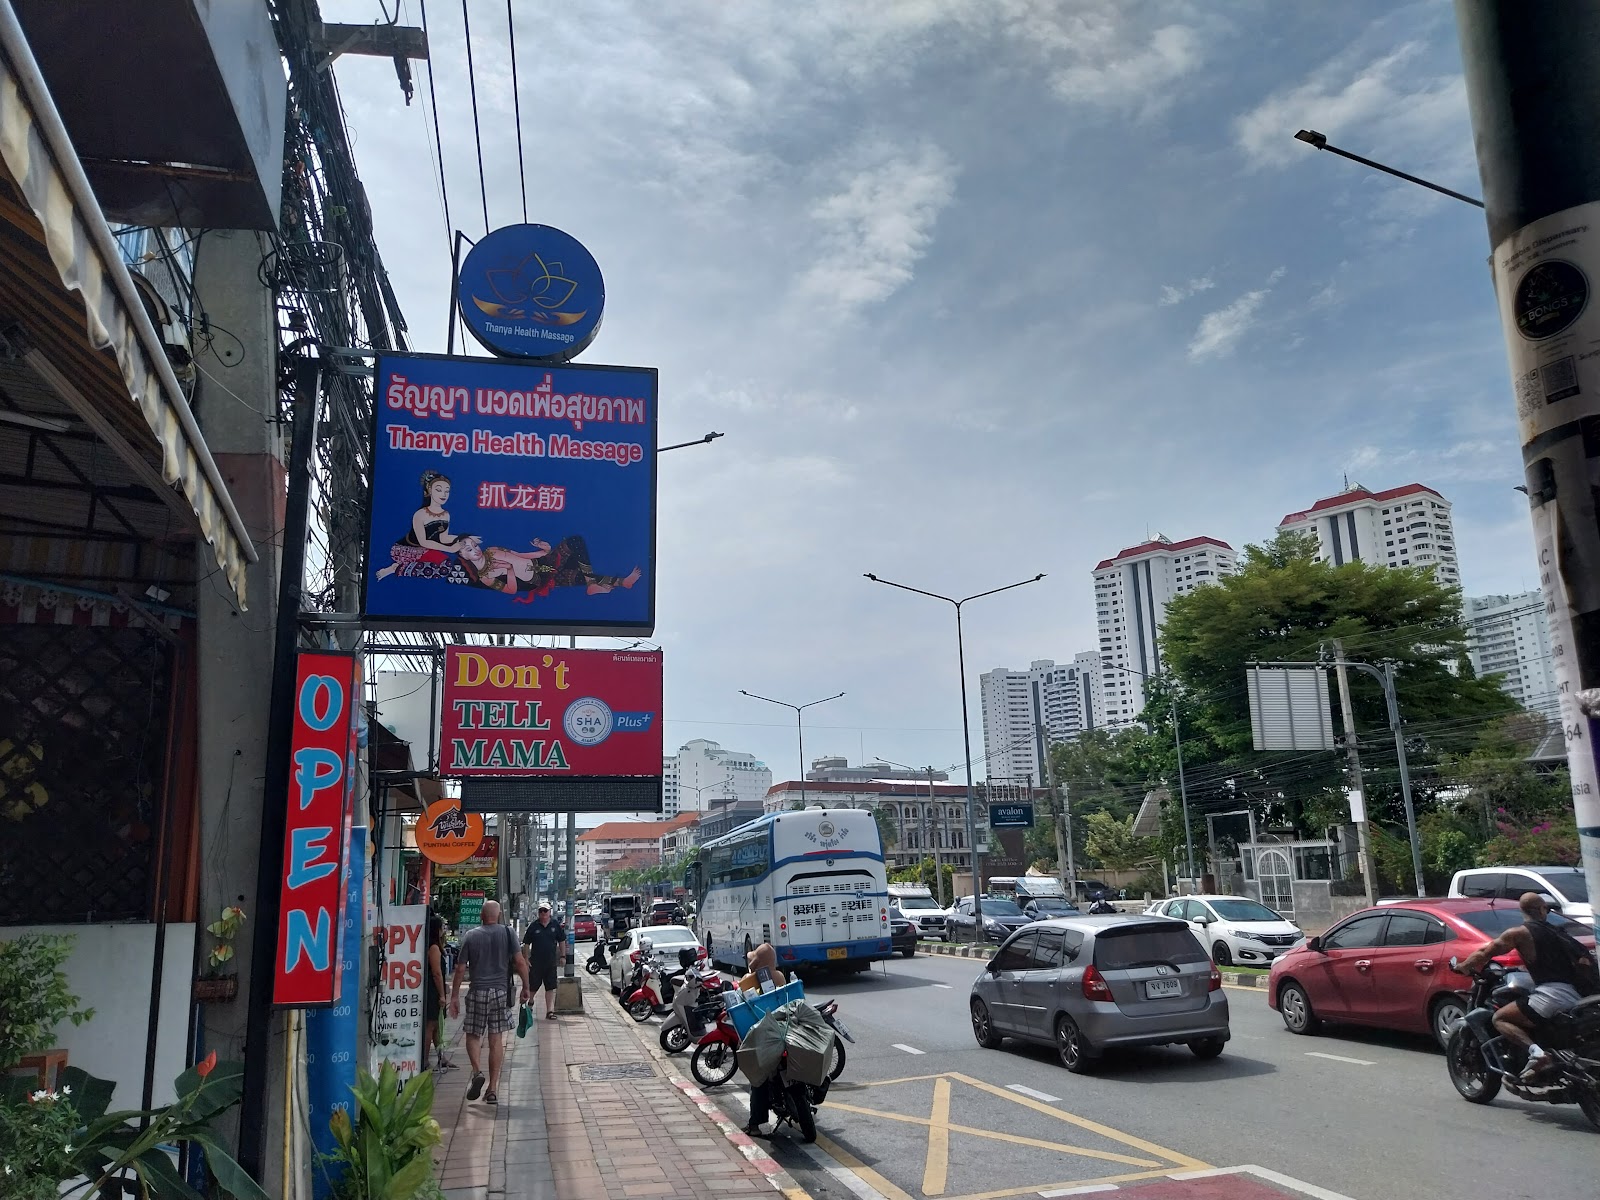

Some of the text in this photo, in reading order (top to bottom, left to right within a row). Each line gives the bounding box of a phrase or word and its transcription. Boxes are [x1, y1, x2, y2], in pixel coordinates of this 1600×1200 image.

[485, 322, 575, 344] Thanya Health Massage
[387, 373, 645, 430] ธัญญา นวดเพื่อสุขภาพ
[386, 425, 643, 466] Thanya Health Massage
[478, 482, 565, 511] 抓龙筋
[454, 652, 570, 690] Don't
[453, 699, 550, 730] TELL
[576, 717, 602, 726] SHA
[450, 738, 570, 770] MAMA
[284, 673, 344, 975] OPEN
[997, 807, 1024, 816] avalon
[333, 1005, 351, 1017] 600
[394, 1008, 408, 1018] 60
[331, 1051, 349, 1063] 650
